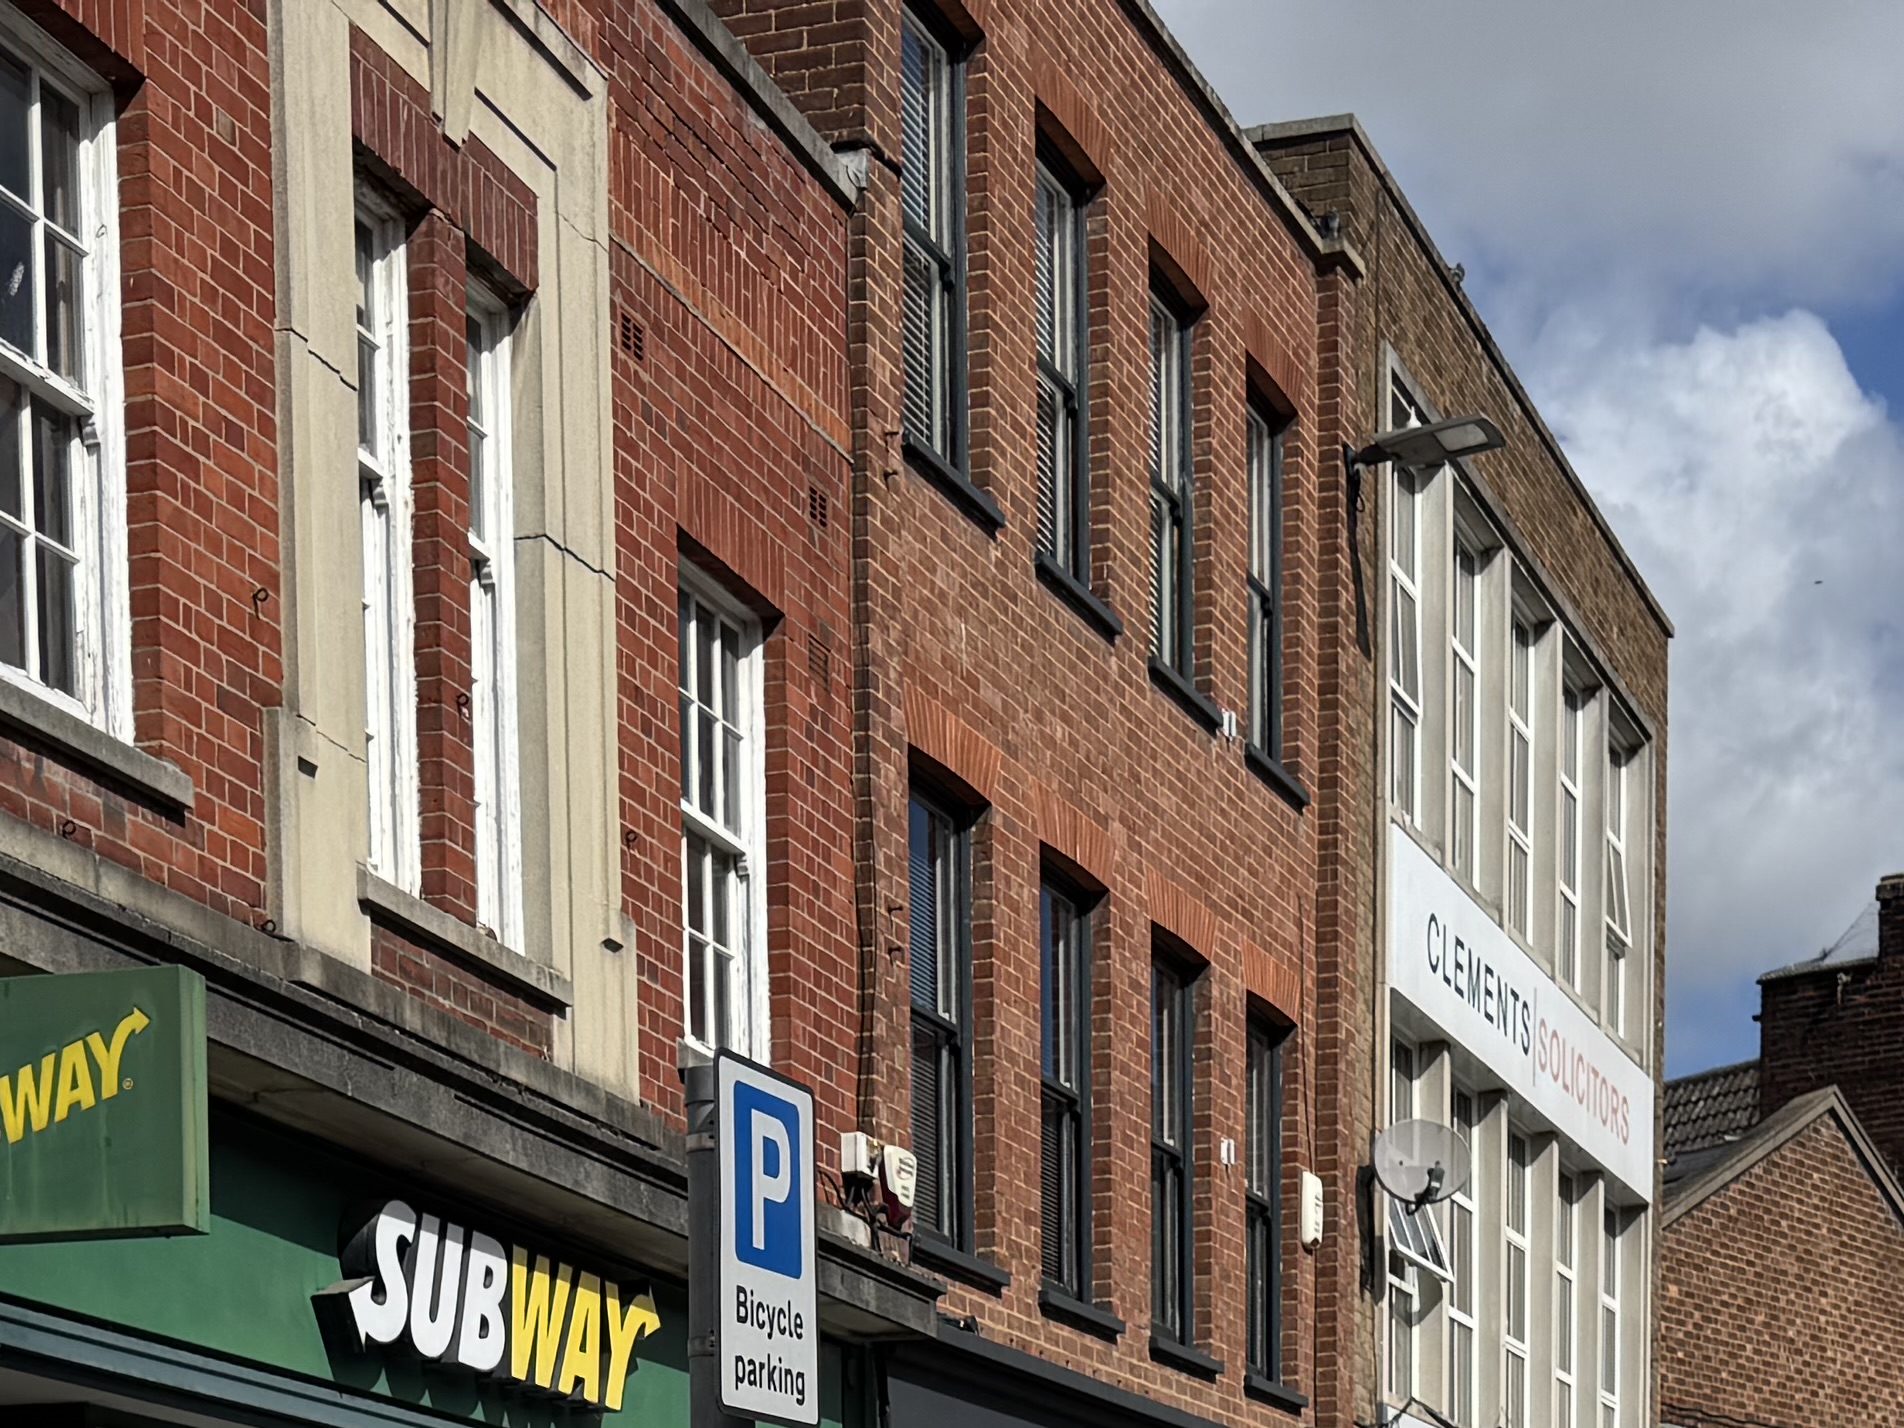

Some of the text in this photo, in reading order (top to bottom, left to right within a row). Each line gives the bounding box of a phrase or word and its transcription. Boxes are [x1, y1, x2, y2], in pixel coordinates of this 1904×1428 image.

[1427, 912, 1530, 1056] CLEMENTS
[1538, 1018, 1630, 1146] SOLICITORS
[751, 1108, 791, 1250] P
[349, 1200, 660, 1411] SUBWAY
[736, 1285, 803, 1341] Bicycle
[734, 1353, 806, 1406] parking
